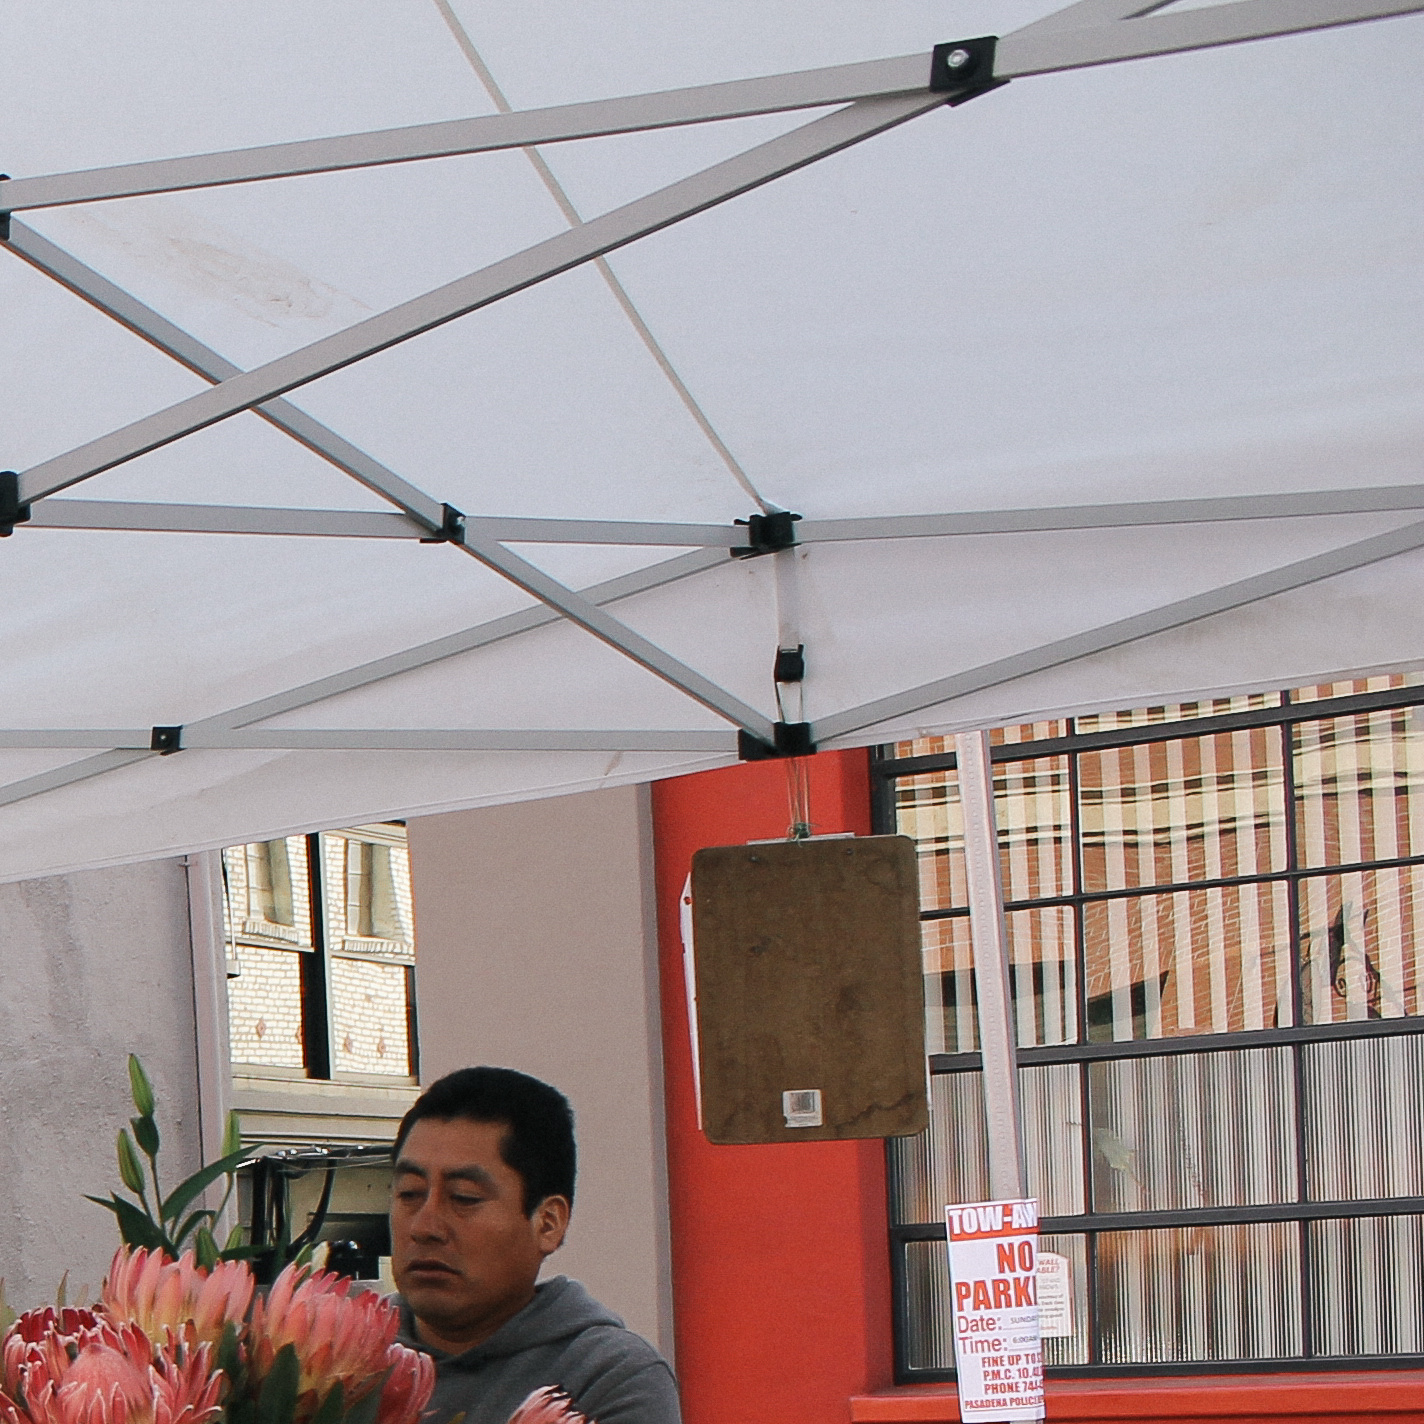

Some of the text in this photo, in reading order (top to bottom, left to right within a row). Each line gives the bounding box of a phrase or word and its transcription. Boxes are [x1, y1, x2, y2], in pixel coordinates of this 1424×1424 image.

[996, 1240, 1034, 1274] NO
[957, 1315, 1002, 1333] Date:
[958, 1336, 1008, 1354] Time:
[981, 1355, 1005, 1368] FINE
[1008, 1354, 1021, 1366] UP
[984, 1381, 1022, 1395] PHONE
[965, 1397, 1008, 1409] PASADENA
